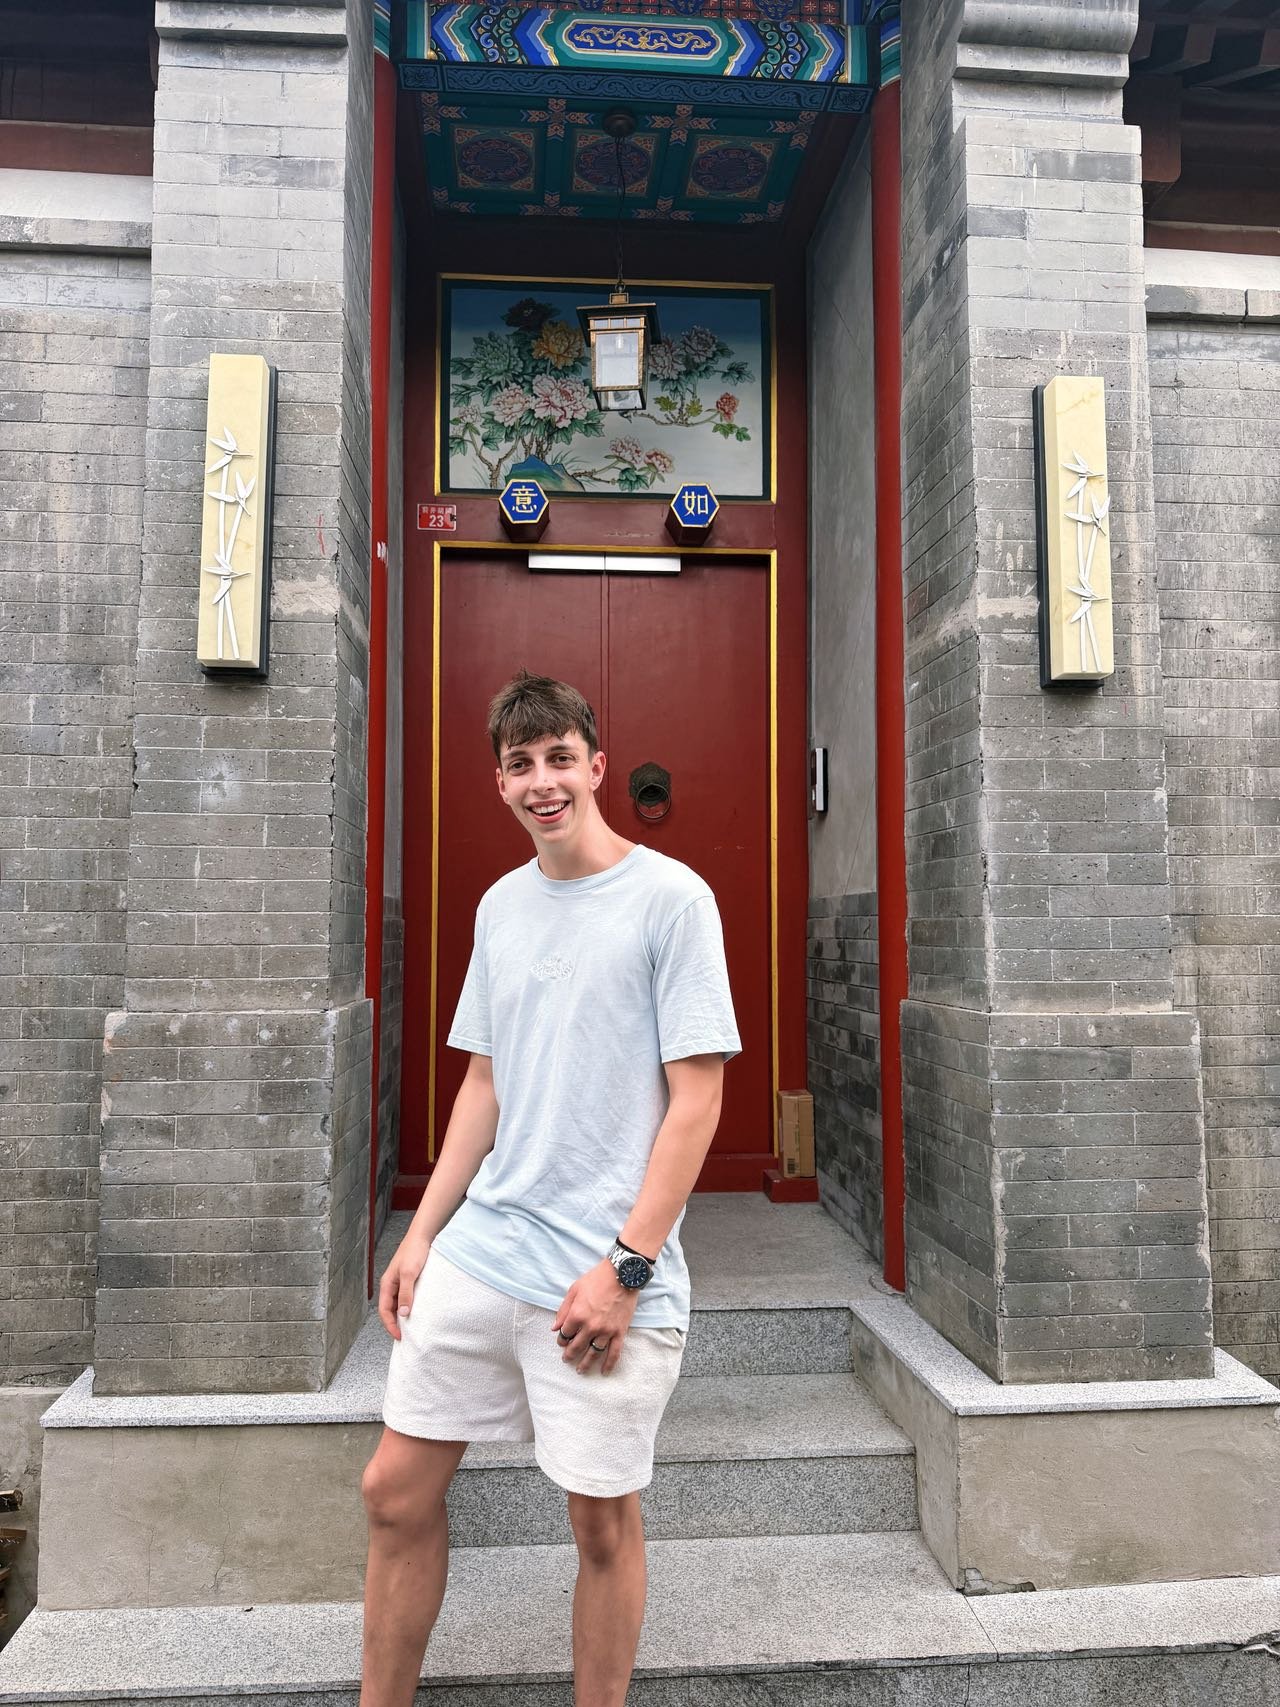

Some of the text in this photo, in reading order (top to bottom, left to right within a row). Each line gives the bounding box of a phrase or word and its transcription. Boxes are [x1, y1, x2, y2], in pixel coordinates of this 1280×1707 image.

[511, 485, 538, 513] 意
[682, 491, 709, 517] 如
[428, 514, 444, 528] 23
